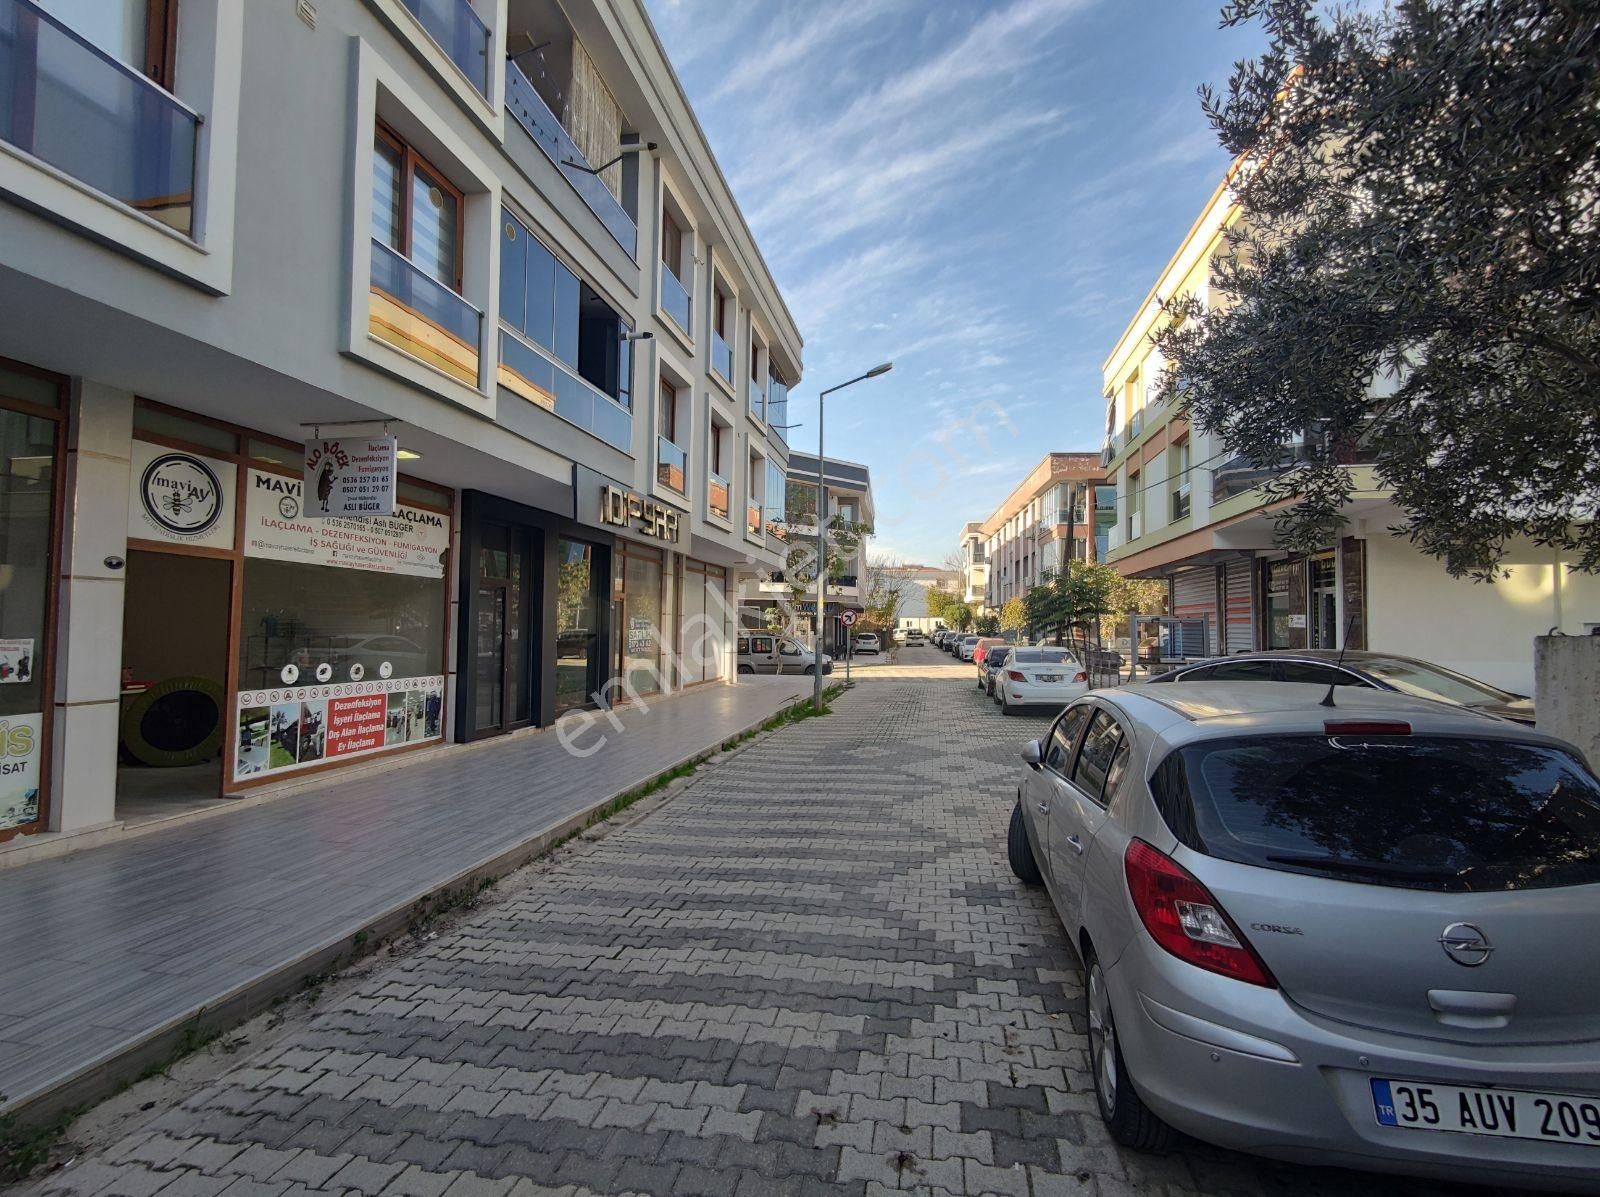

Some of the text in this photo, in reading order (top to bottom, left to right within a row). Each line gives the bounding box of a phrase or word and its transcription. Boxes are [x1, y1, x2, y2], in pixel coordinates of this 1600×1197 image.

[307, 442, 349, 470] ALO BÖCEK
[359, 502, 380, 510] BÜGER
[261, 516, 313, 534] İLAÇLAMA
[322, 528, 387, 546] DEZENFEKSİYON
[388, 520, 414, 533] BÜGER
[310, 537, 318, 547] İŞ
[320, 539, 354, 551] SAĞLIĞI
[335, 698, 381, 710] Dezenfeksiyon
[329, 730, 340, 740] Dış
[341, 728, 356, 737] Alan
[338, 743, 346, 751] Ev
[1378, 1104, 1394, 1116] TR
[1397, 1087, 1600, 1140] 35 AUV 209
